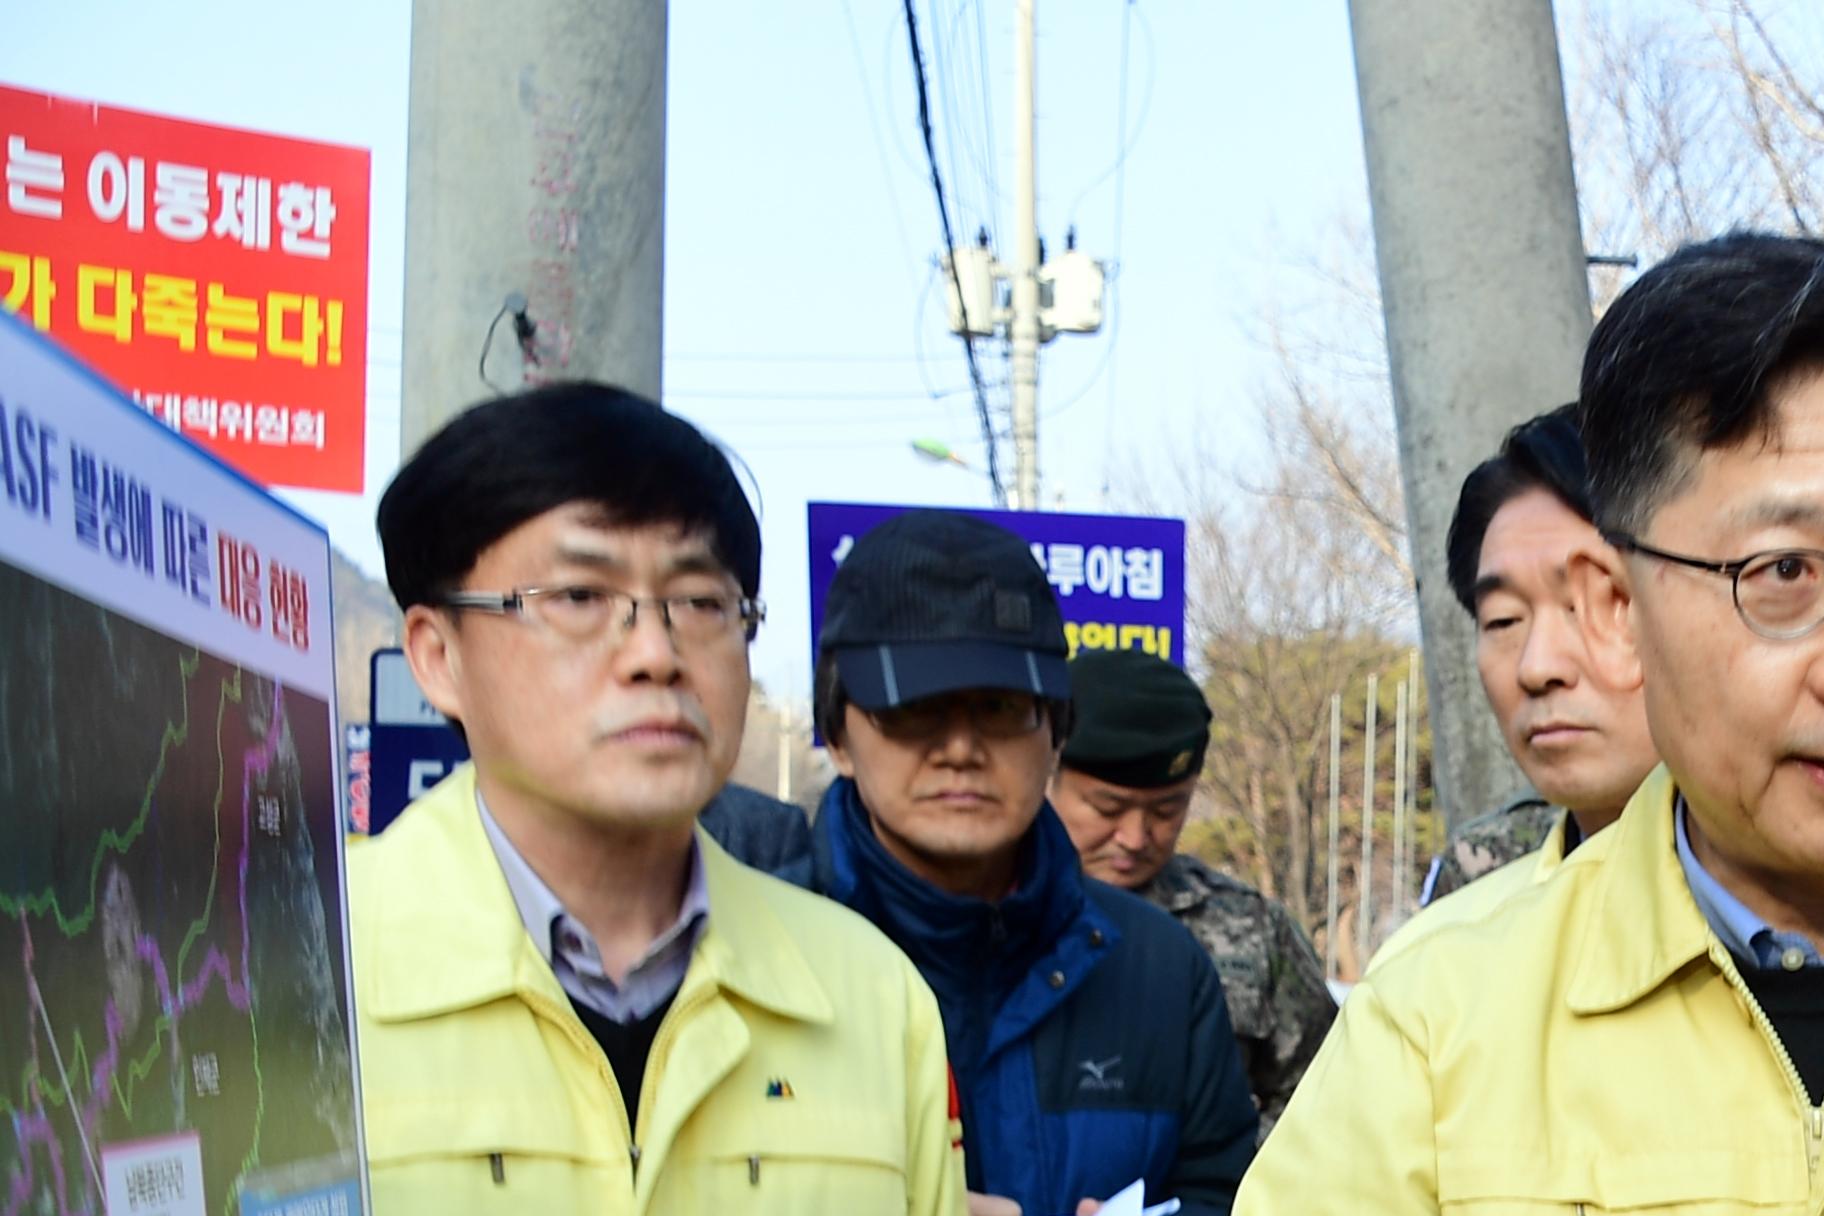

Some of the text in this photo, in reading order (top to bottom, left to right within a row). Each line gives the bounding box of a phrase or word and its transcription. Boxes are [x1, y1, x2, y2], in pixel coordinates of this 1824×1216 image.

[6, 134, 336, 260] 는 이동제한
[77, 263, 344, 367] 다죽는다!
[133, 388, 326, 450] 대책위원회
[69, 432, 155, 582] 발생에
[161, 493, 211, 609] 따른
[217, 529, 262, 632] 대응
[268, 556, 310, 653] 현황
